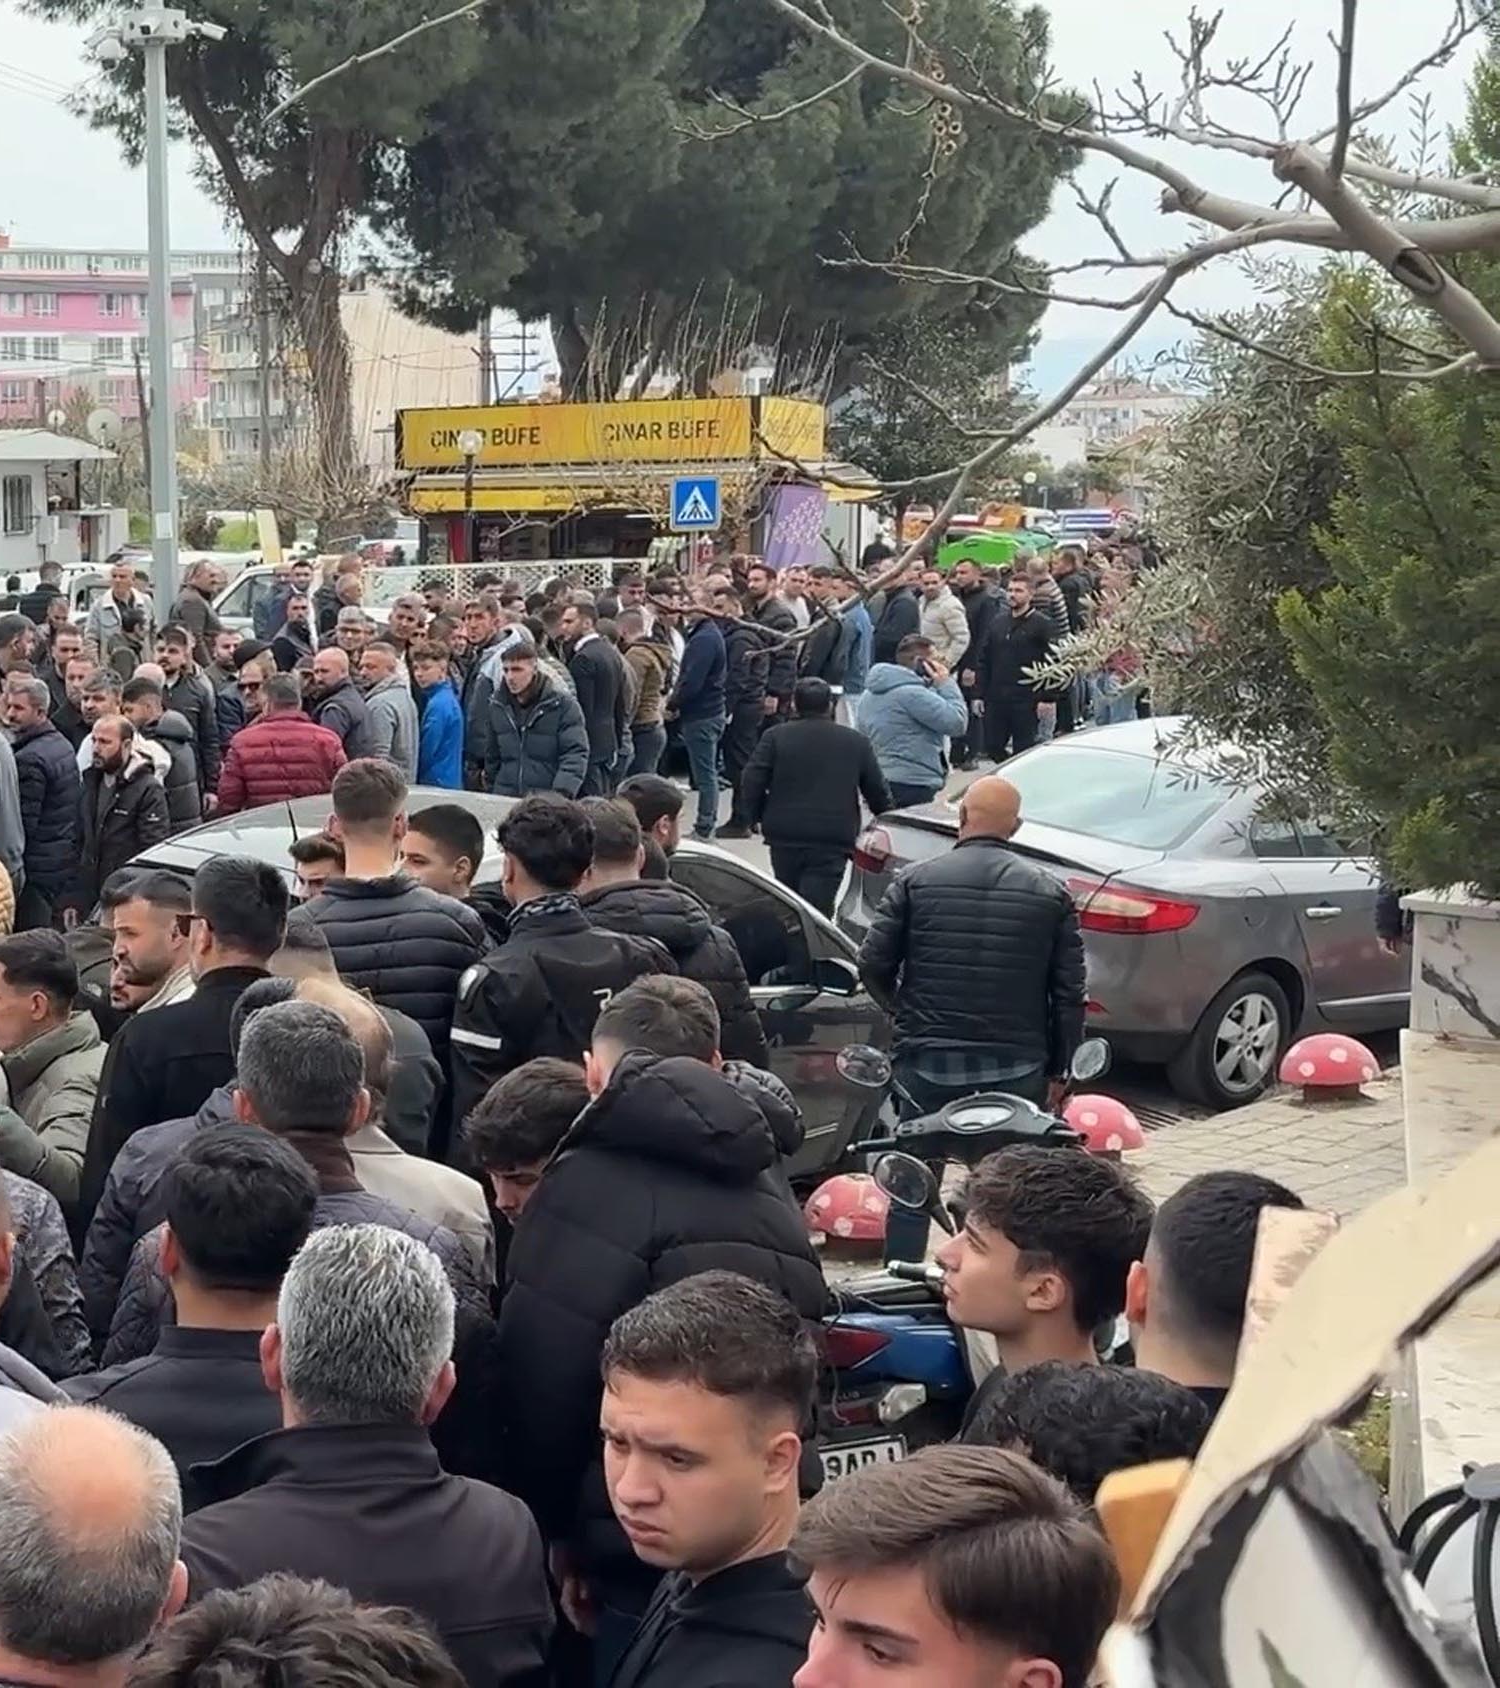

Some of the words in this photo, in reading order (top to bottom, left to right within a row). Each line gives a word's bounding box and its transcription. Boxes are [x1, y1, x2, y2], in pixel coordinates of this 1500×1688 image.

[430, 428, 487, 453] ÇINR
[492, 423, 541, 447] BÜFE
[602, 421, 662, 447] ÇINAR
[667, 416, 721, 440] BÜFE
